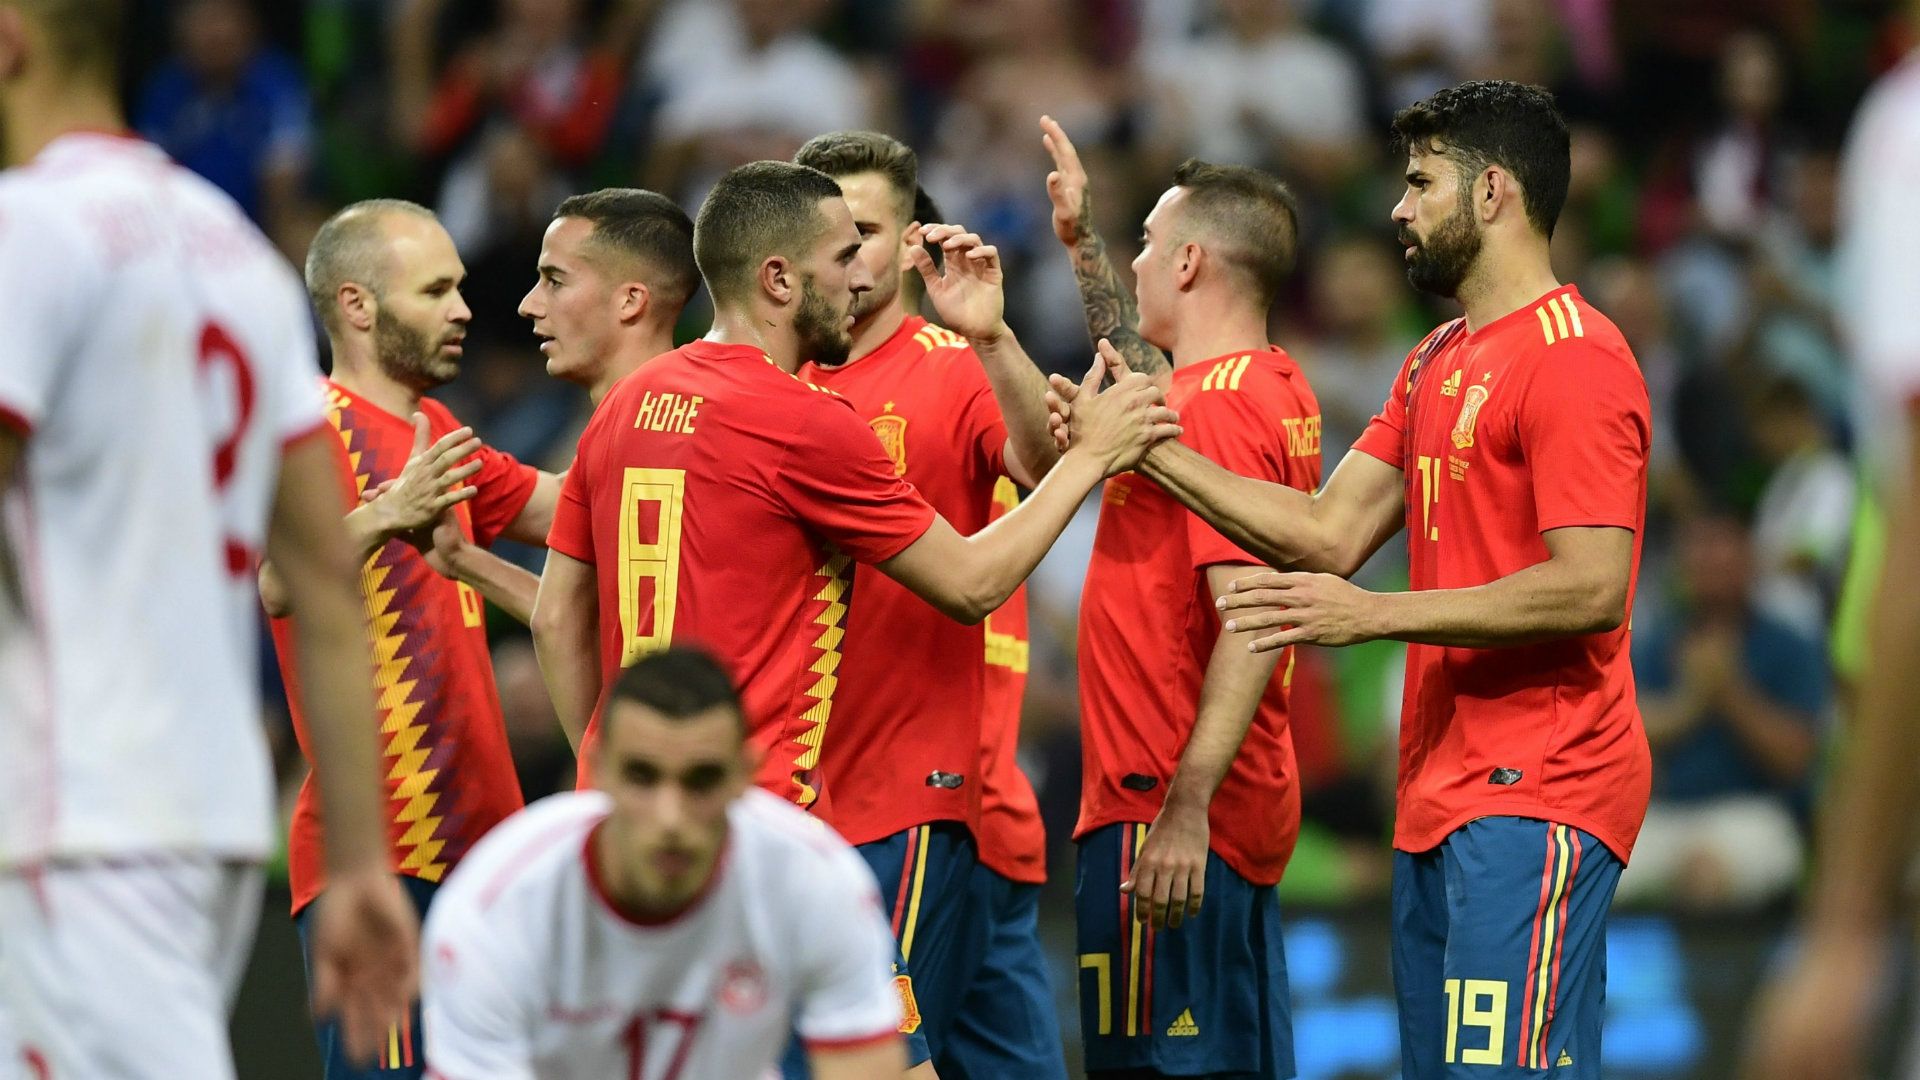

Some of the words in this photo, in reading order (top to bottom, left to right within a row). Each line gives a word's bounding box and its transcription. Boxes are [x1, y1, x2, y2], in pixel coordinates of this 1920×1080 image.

[634, 391, 703, 433] KOKE
[618, 467, 686, 668] 8
[1445, 979, 1508, 1065] 19
